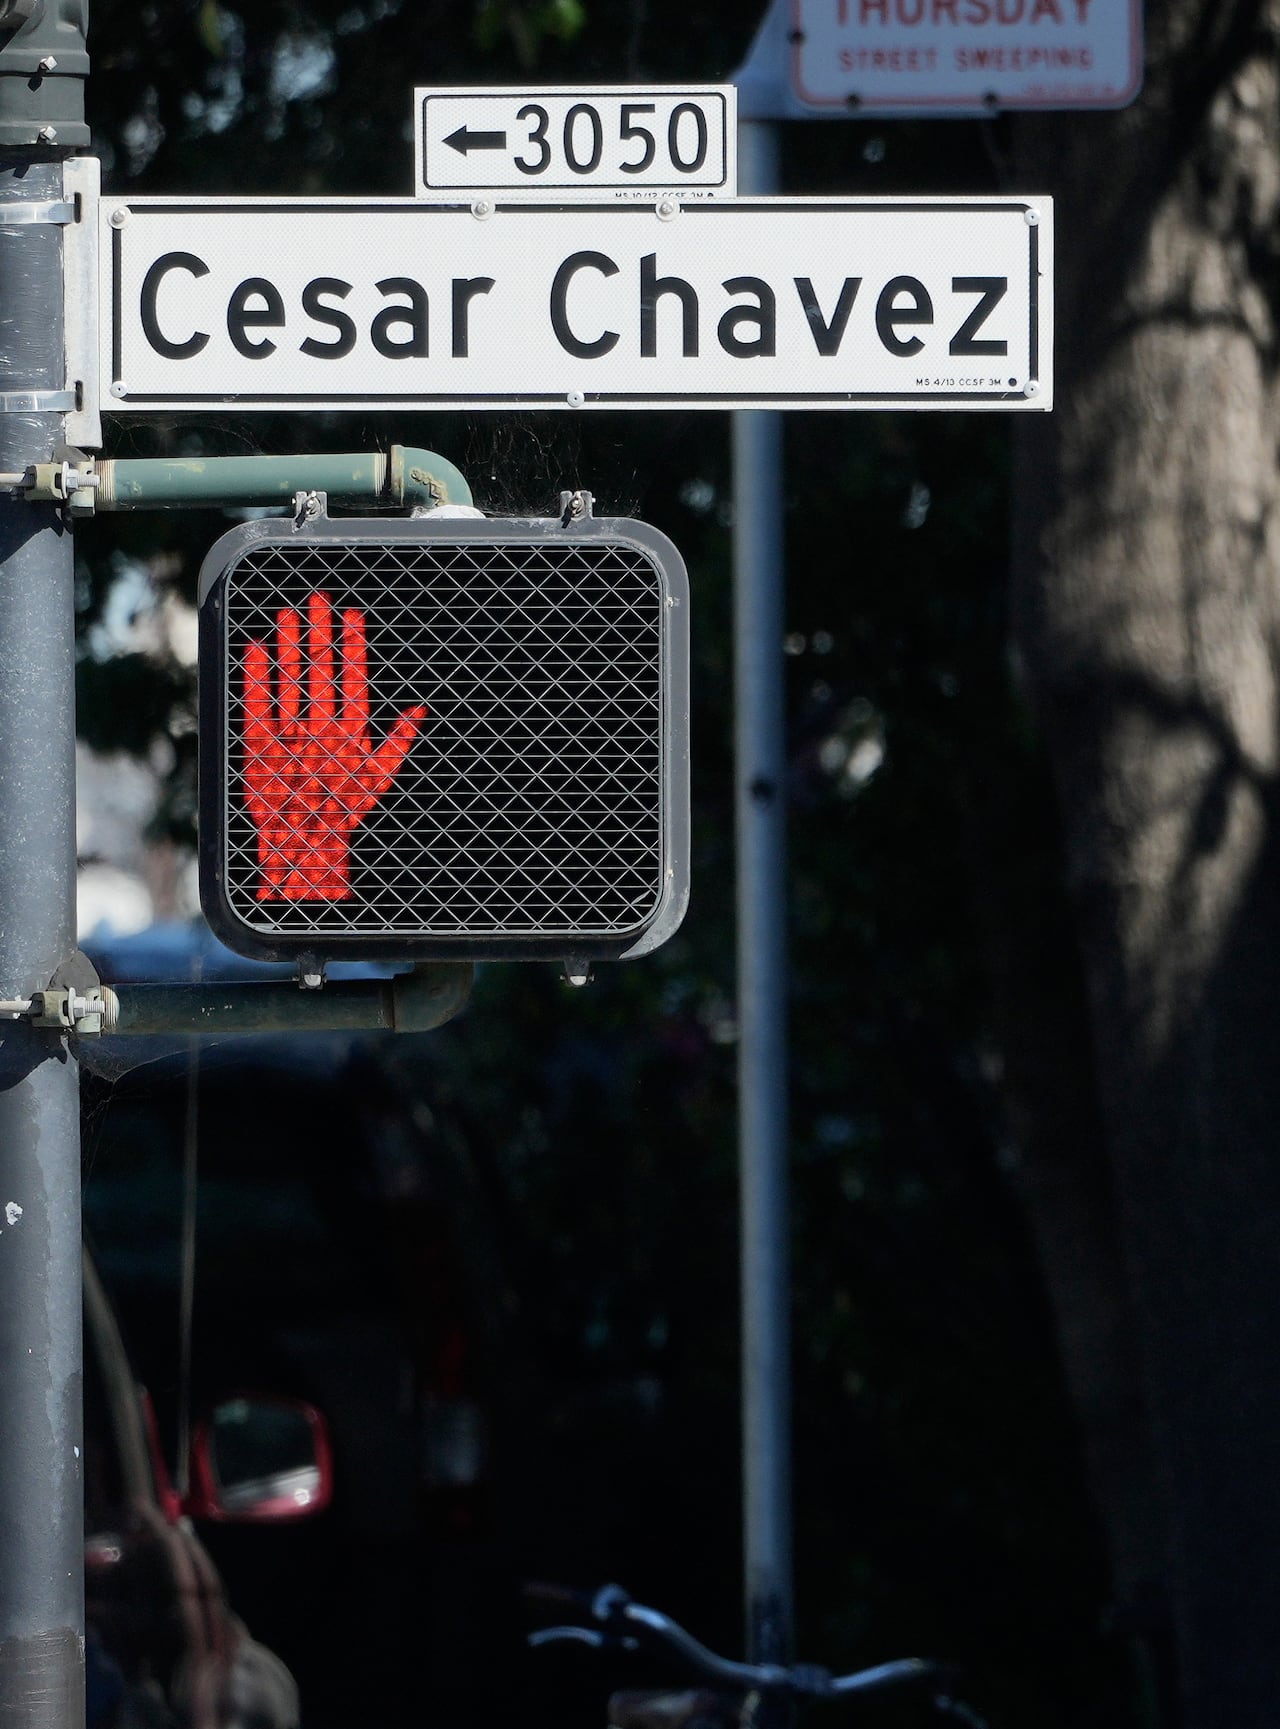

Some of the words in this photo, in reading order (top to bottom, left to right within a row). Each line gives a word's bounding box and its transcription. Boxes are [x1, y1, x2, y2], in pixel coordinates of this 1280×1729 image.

[838, 46, 939, 72] STREET
[953, 46, 1093, 72] SWEEPING
[513, 102, 708, 175] 3050
[140, 251, 496, 360] Cesar
[550, 250, 1008, 359] Chavez
[916, 378, 930, 386] MS
[933, 378, 955, 386] 4/13
[958, 378, 985, 386] CCSF
[988, 378, 1001, 386] 3M
